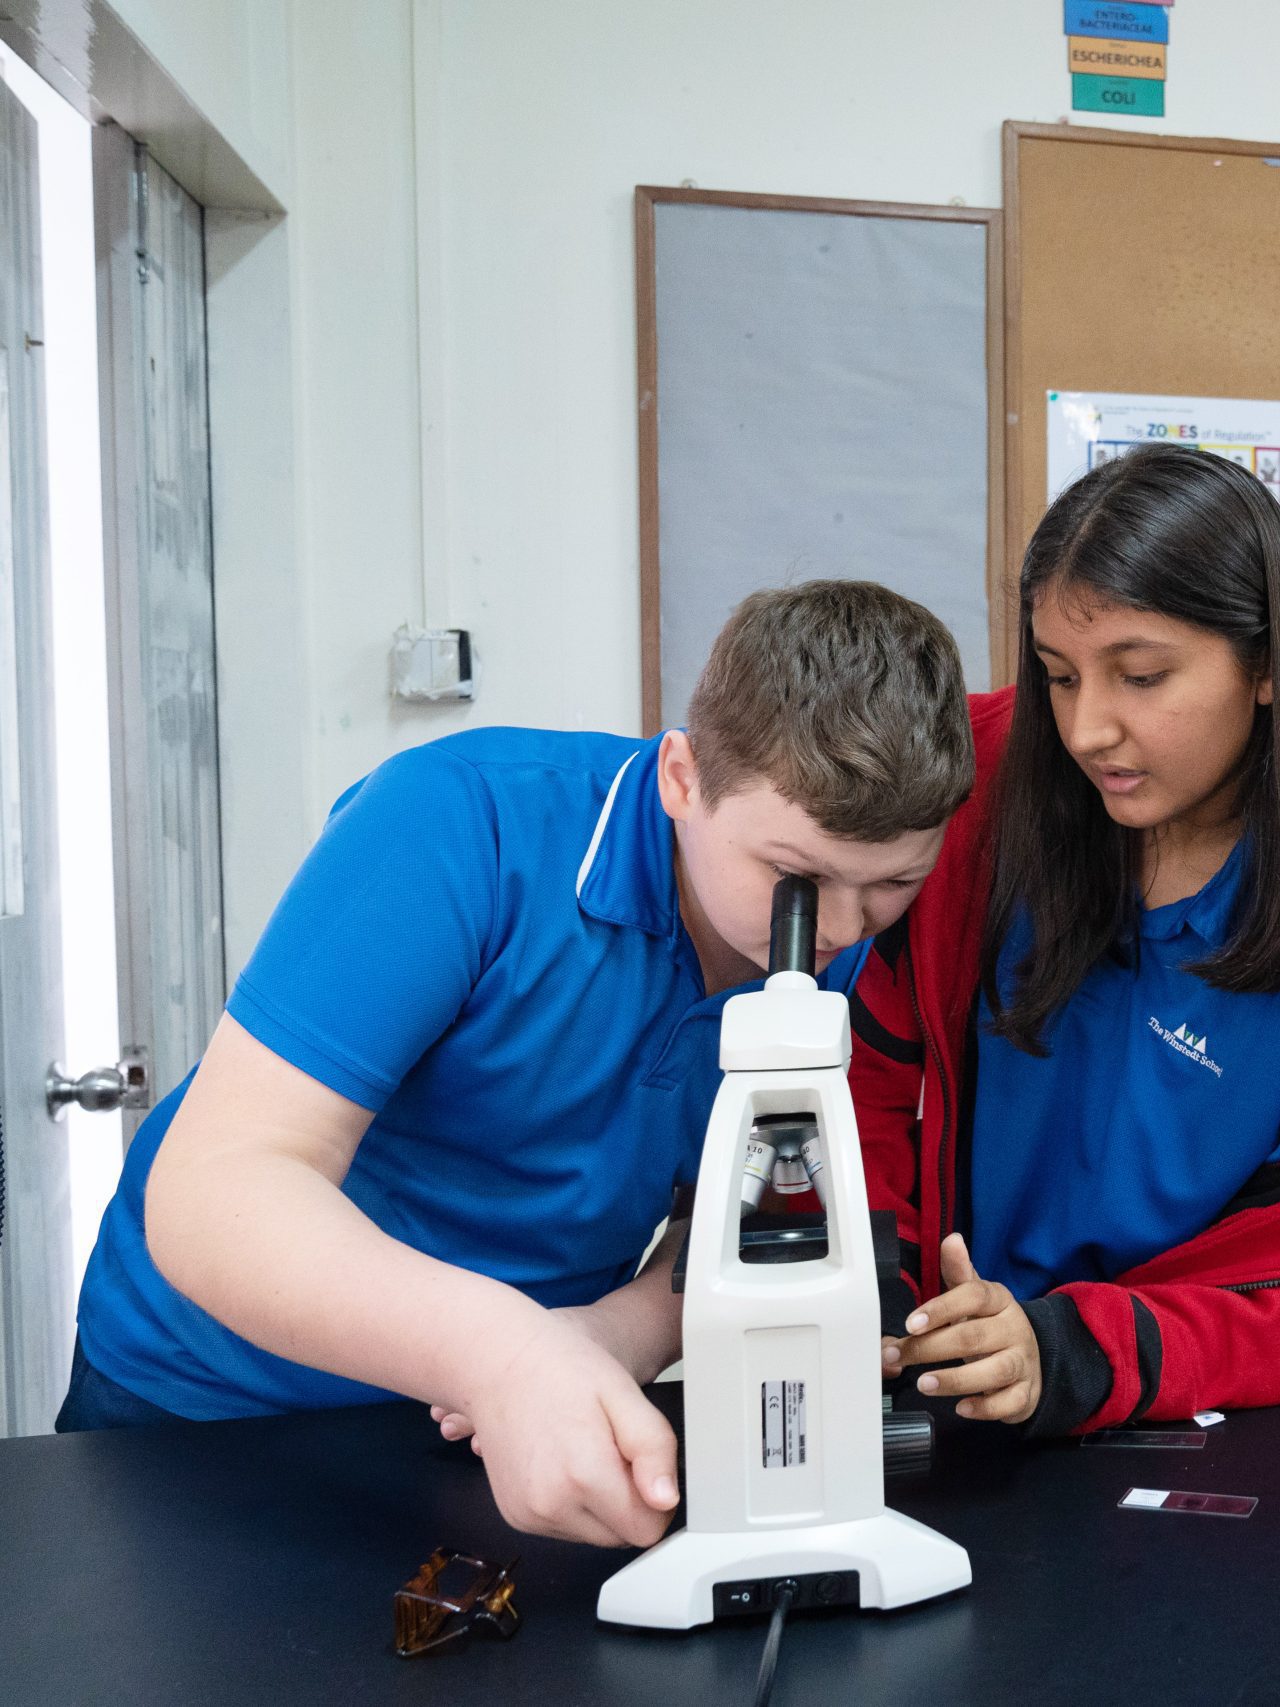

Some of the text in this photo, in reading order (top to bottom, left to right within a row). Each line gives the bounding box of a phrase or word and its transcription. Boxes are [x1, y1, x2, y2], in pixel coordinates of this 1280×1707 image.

[1073, 50, 1162, 68] ESCHERICHEA
[1102, 90, 1136, 105] COLI
[1146, 422, 1199, 438] ZONES
[1147, 1016, 1164, 1036] The
[1163, 1029, 1201, 1062] Winstedt
